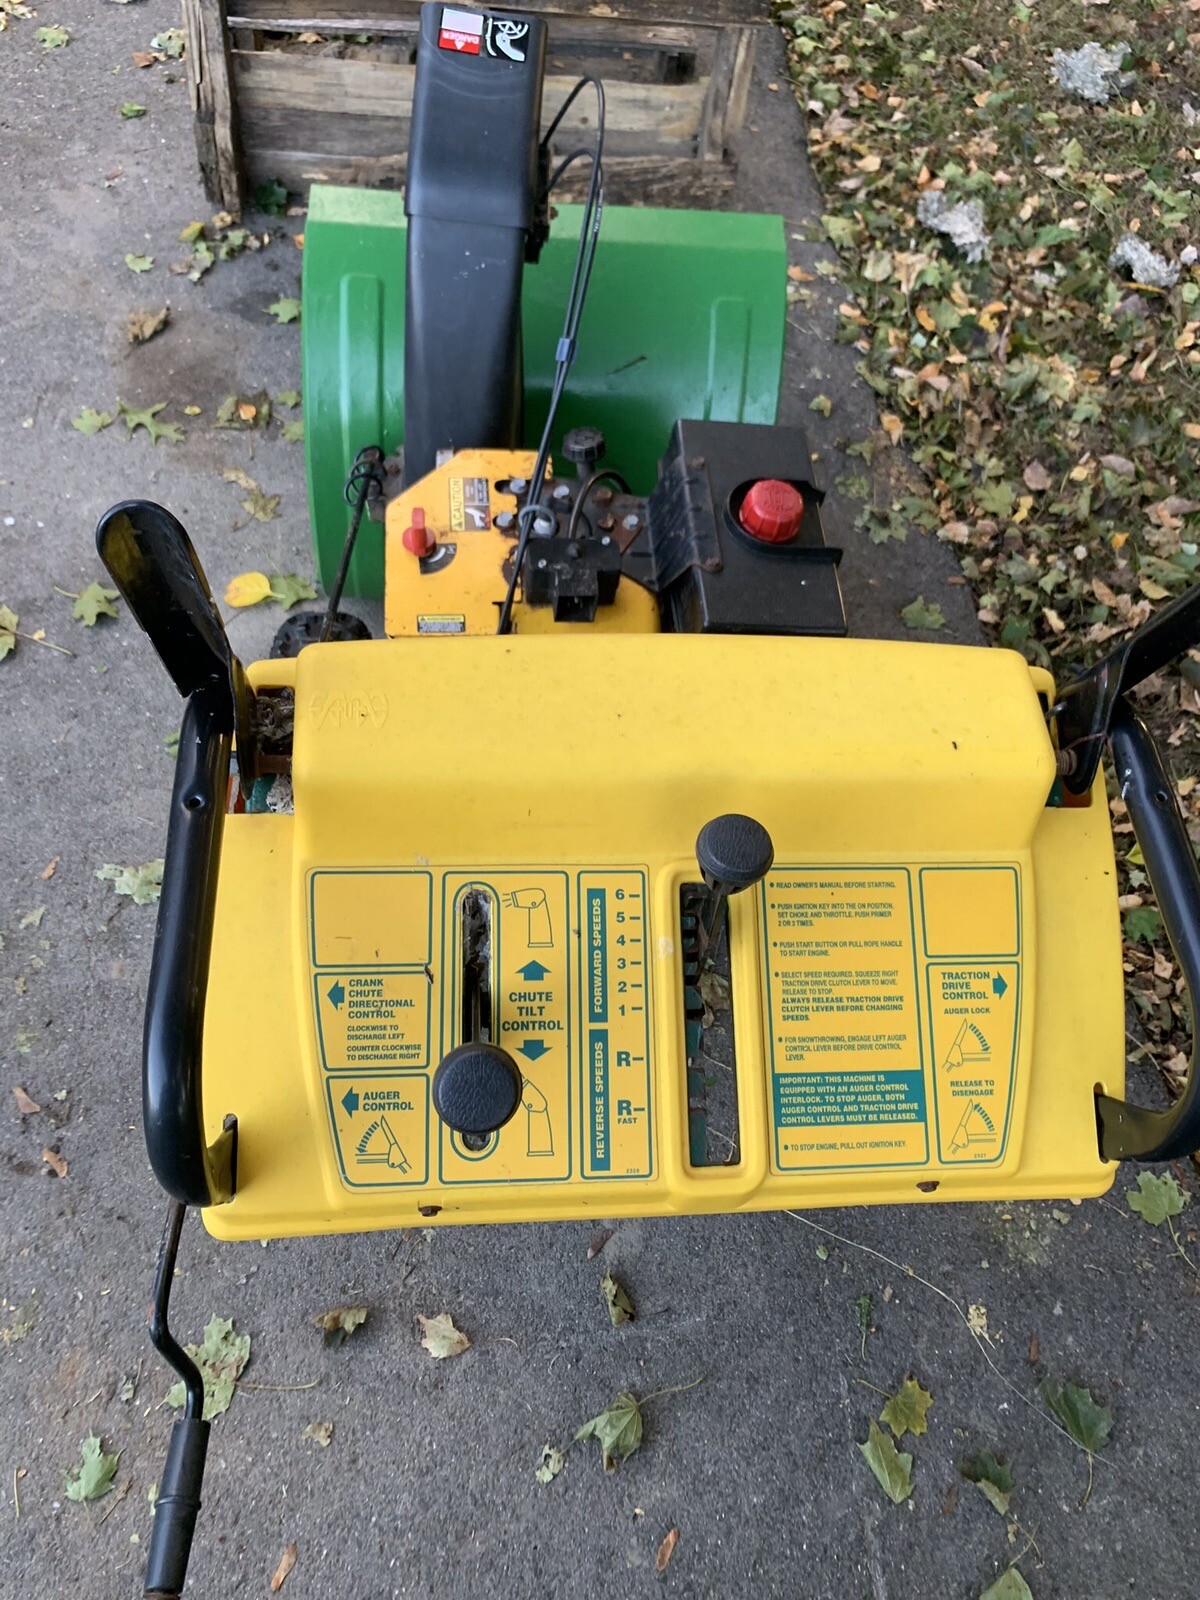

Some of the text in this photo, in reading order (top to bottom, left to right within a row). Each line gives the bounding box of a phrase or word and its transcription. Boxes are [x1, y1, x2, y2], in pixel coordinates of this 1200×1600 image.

[443, 31, 479, 44] DANGER
[453, 480, 463, 520] CAUTION
[616, 889, 624, 900] 6
[617, 912, 625, 922] 5
[617, 935, 626, 945] 4
[593, 898, 602, 1013] FORWARD SPEEDS
[617, 958, 626, 969] 3
[941, 972, 990, 980] TRACTION
[349, 979, 383, 987] CRANK
[618, 981, 627, 992] 2
[349, 990, 383, 998] CHUTE
[509, 992, 553, 1002] CHUTE
[349, 1000, 415, 1008] DIRECTIONAL
[348, 1010, 396, 1018] CONTROL
[517, 1006, 545, 1016] TILT
[619, 1005, 625, 1016] 1
[502, 1020, 564, 1031] CONTROL
[363, 1091, 400, 1100] AUGER
[595, 1042, 604, 1158] REVERSE SPEEDS
[363, 1102, 414, 1111] CONTROL
